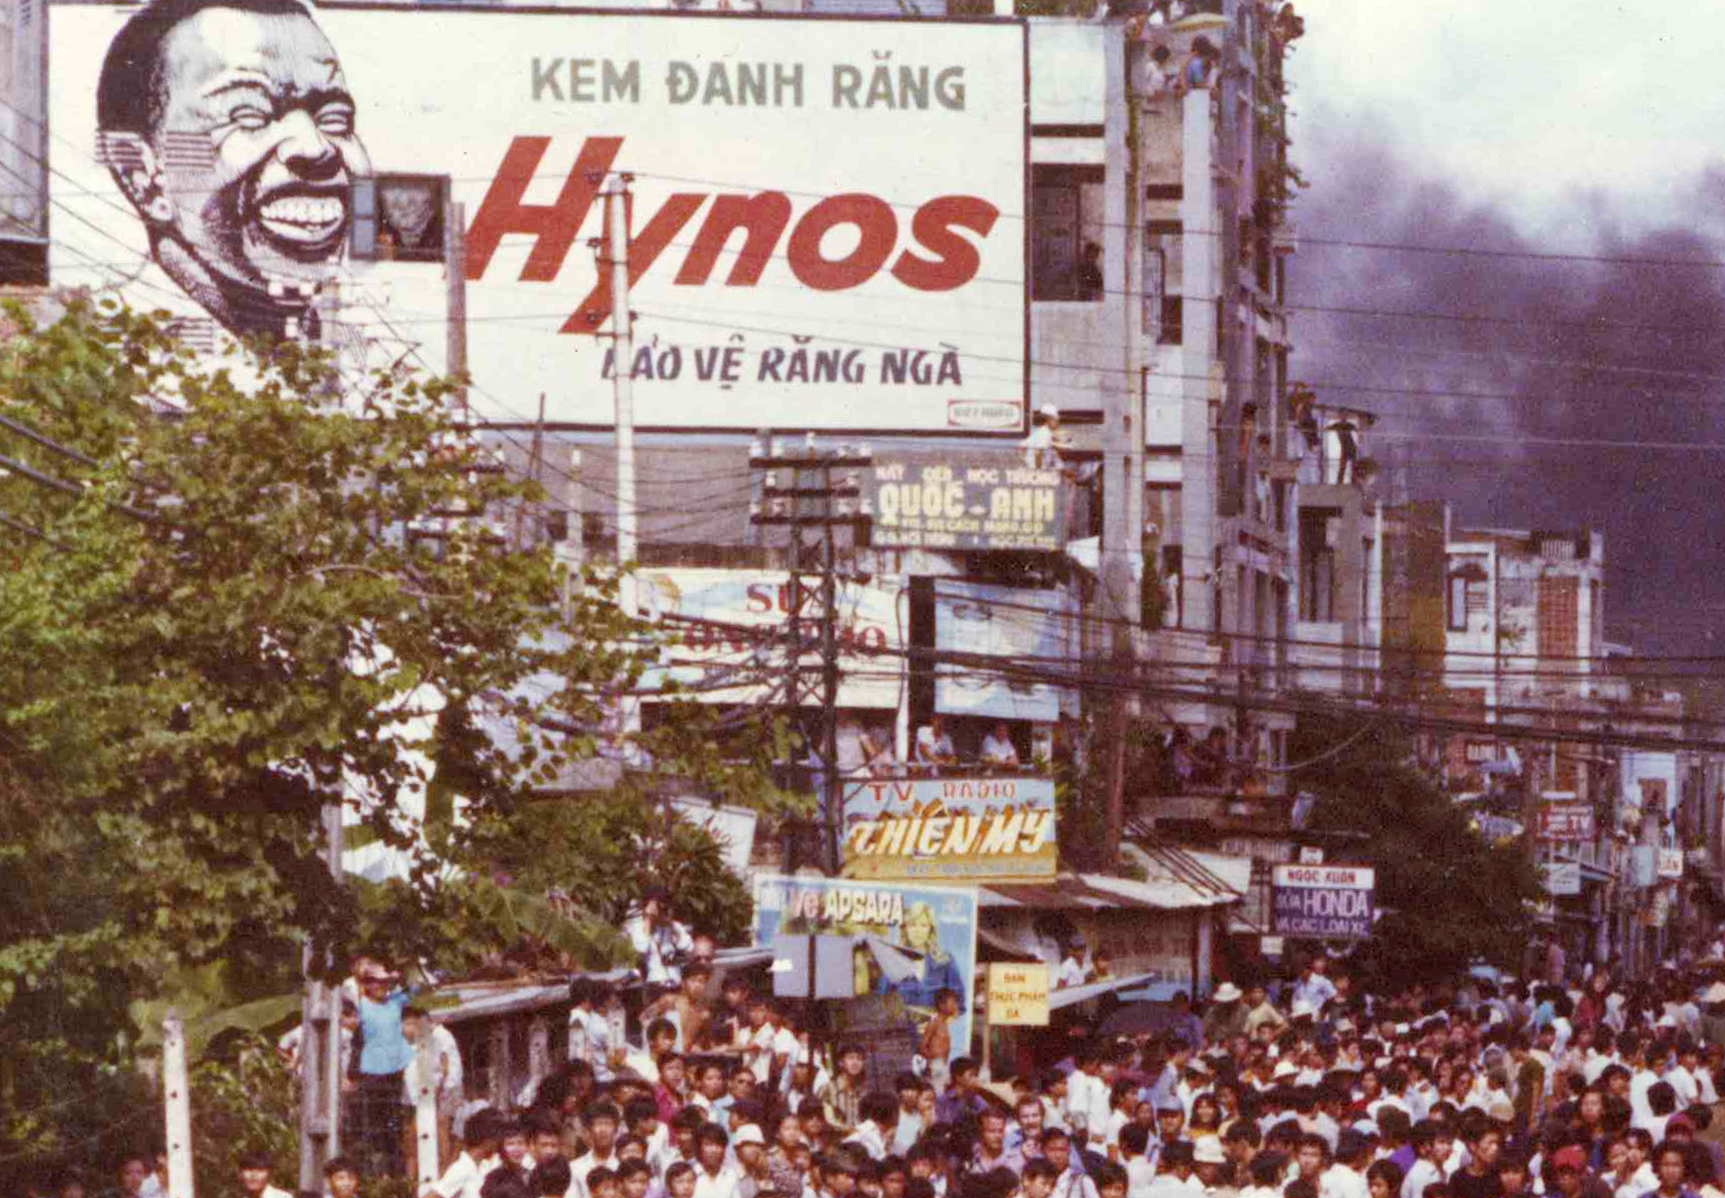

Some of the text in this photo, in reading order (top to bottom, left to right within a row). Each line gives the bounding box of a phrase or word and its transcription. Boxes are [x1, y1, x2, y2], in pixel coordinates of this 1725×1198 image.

[531, 49, 966, 111] KEM ĐANH RĂNG
[444, 136, 1000, 333] Hynos
[694, 334, 745, 389] VỆ
[757, 334, 866, 384] RĂNG
[880, 342, 962, 386] NGÀ
[866, 782, 1016, 801] TV RADIO
[823, 888, 904, 926] APSARA
[1303, 889, 1369, 917] HONDA
